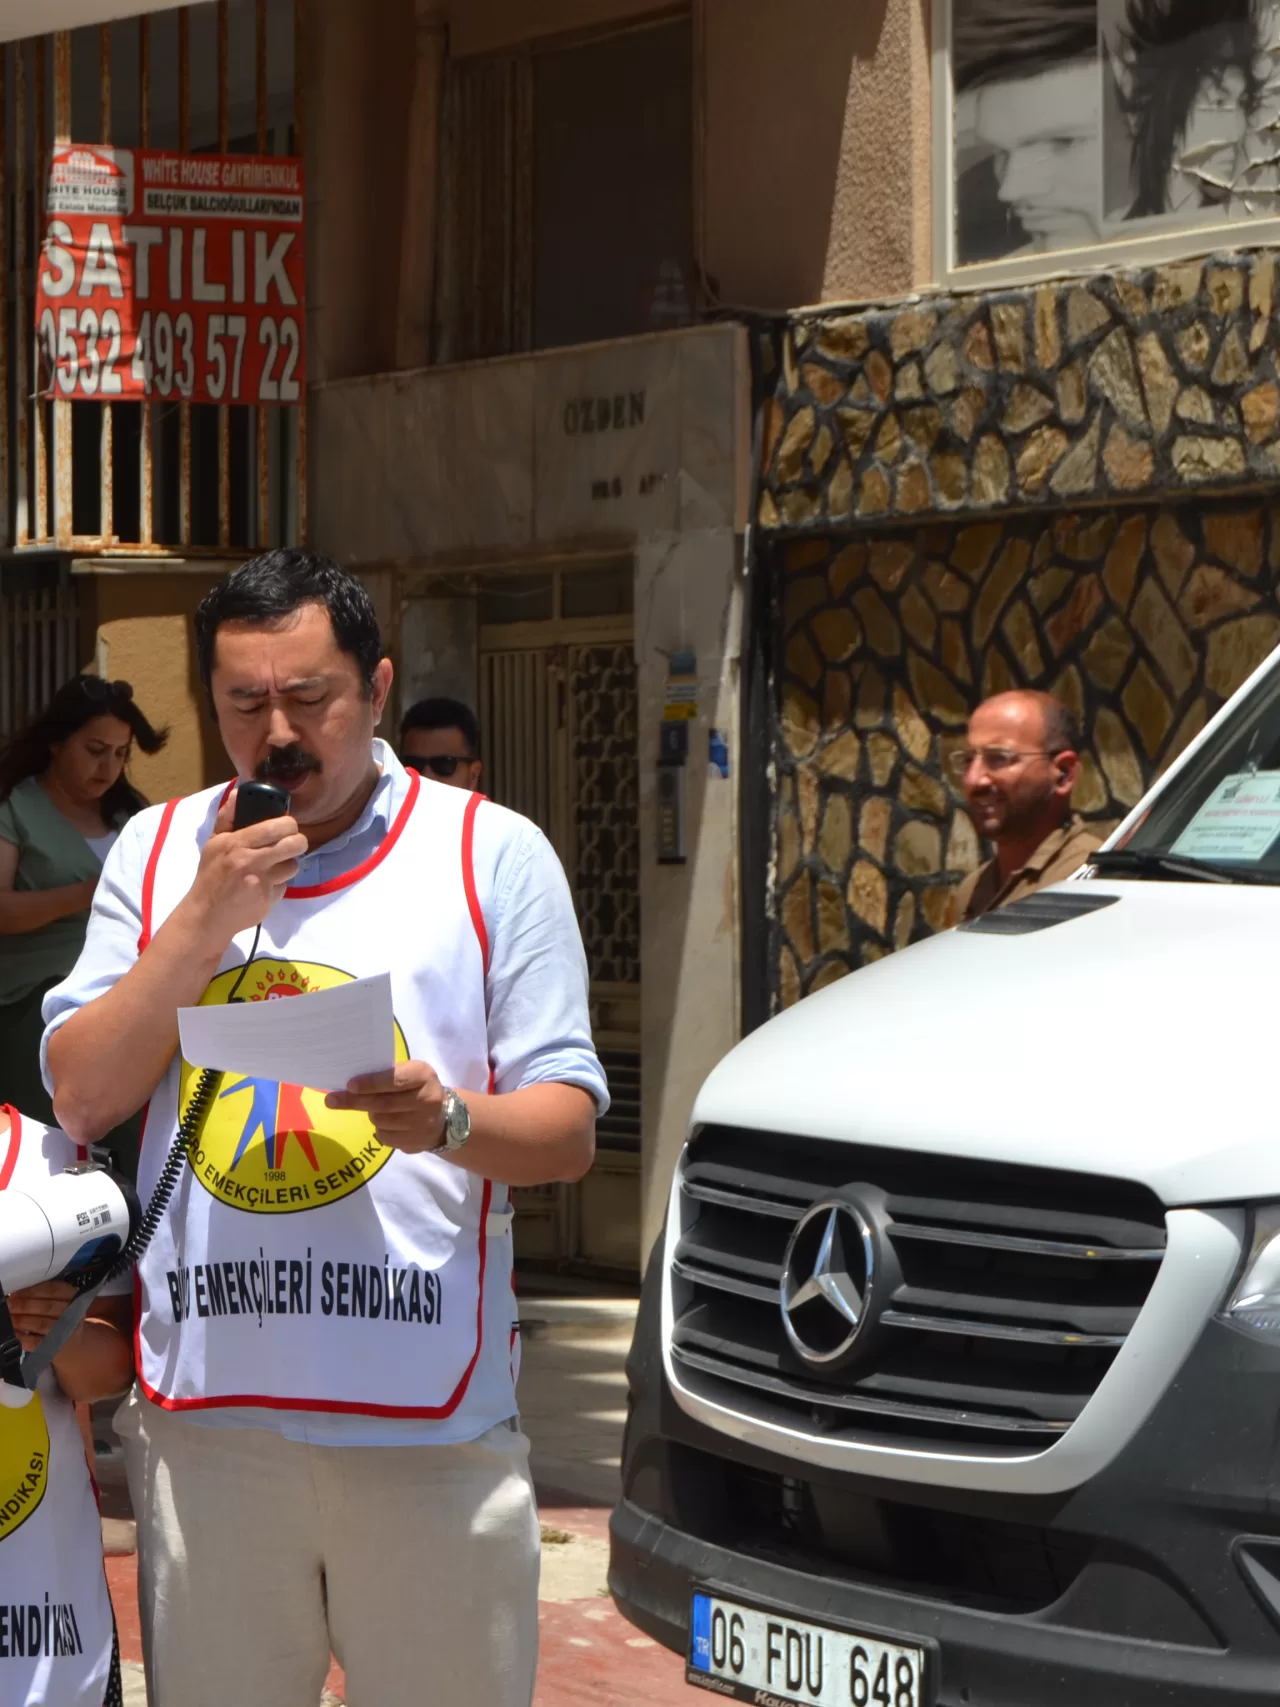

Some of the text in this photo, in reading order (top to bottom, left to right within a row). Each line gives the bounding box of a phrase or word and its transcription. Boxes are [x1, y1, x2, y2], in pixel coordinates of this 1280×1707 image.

[181, 160, 220, 186] HOUSE
[41, 220, 298, 305] SATILIK
[40, 307, 300, 401] 0532 493 57 22
[204, 1165, 310, 1206] EMEKÇİLERİ
[314, 1133, 386, 1197] SENDİK
[263, 1171, 286, 1181] 1998
[194, 1247, 312, 1328] EMEKÇİLERİ
[320, 1254, 442, 1325] SENDİKASI
[696, 1636, 710, 1656] TR
[711, 1607, 914, 1707] 06 FDU 648
